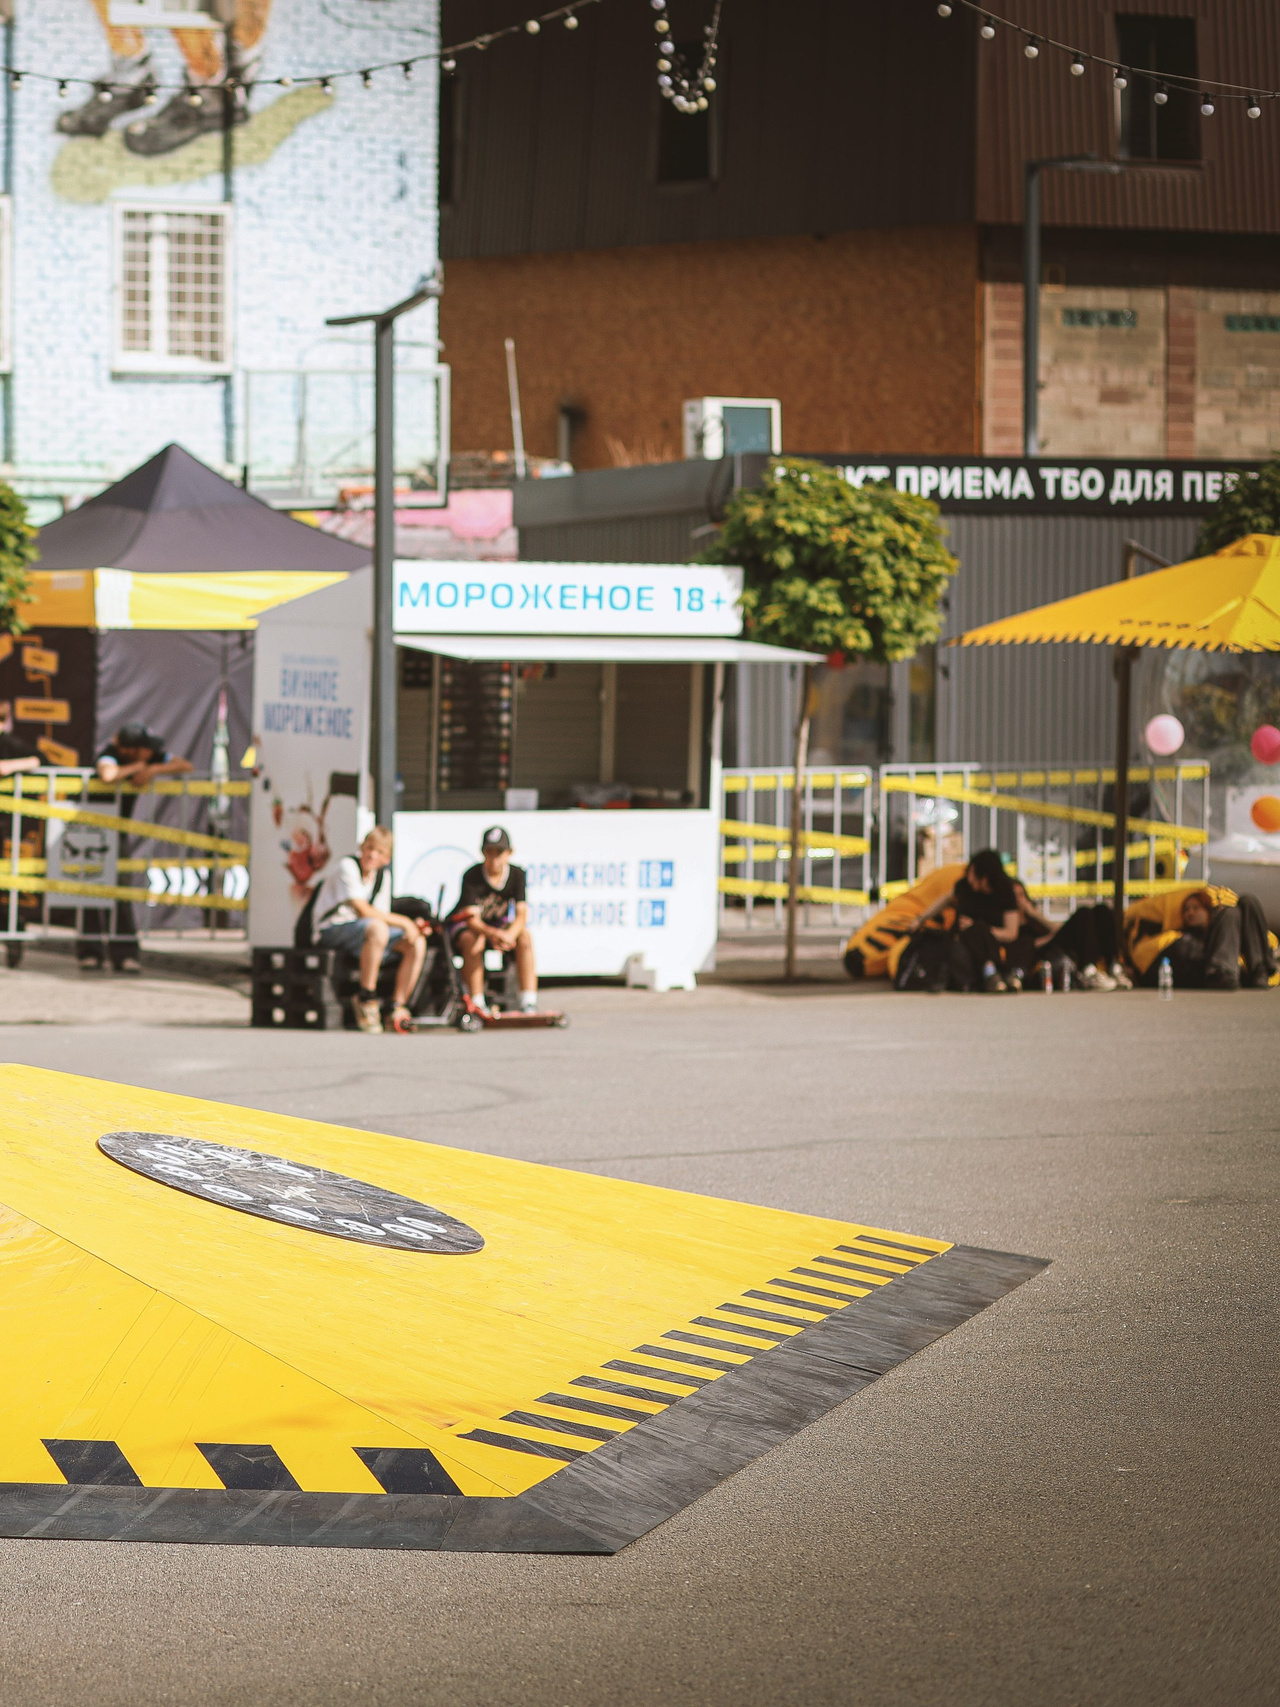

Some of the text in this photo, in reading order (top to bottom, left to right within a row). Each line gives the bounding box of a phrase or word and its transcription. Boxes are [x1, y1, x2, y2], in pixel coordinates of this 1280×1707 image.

[895, 465, 1036, 500] ПРИЕМА
[1038, 466, 1105, 501] ТБО
[1108, 468, 1174, 505] ДЛЯ
[398, 582, 728, 612] МОРОЖЕНОЕ 18+
[263, 702, 352, 739] МОРОЖЕНОЕ
[525, 861, 673, 888] ОРОЖЕНОЕ 18+
[525, 902, 627, 927] ОРОЖЕНОЕ
